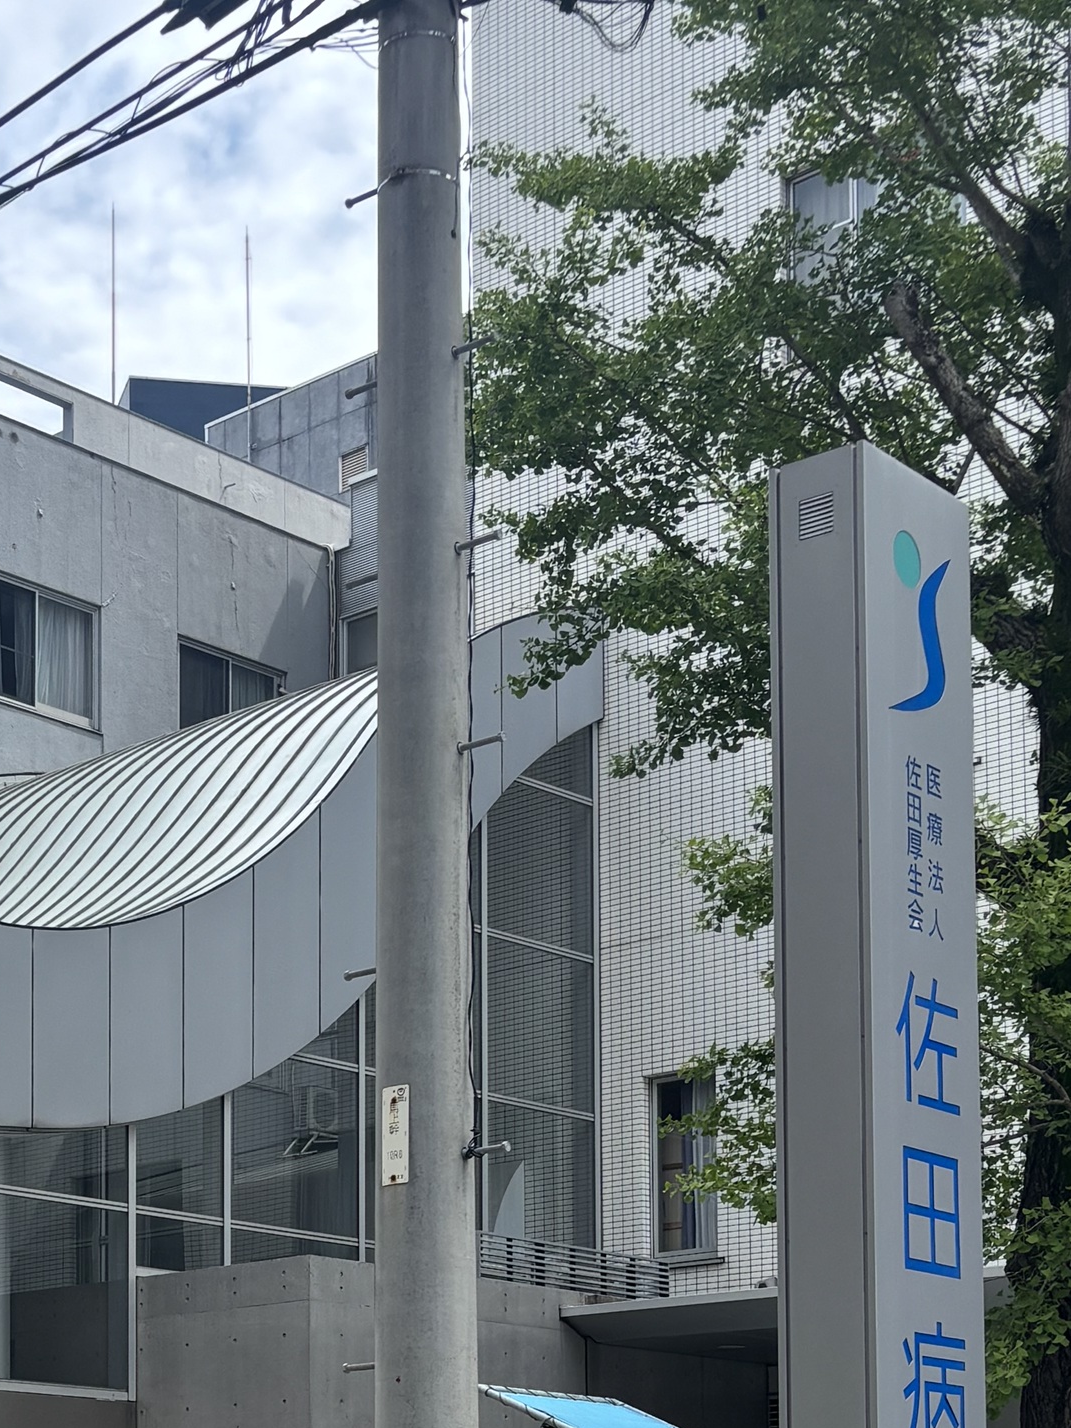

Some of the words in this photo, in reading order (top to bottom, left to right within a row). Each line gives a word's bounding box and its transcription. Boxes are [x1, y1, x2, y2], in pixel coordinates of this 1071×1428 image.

[904, 755, 925, 934] 佐田厚生会
[925, 762, 945, 942] 医療法人
